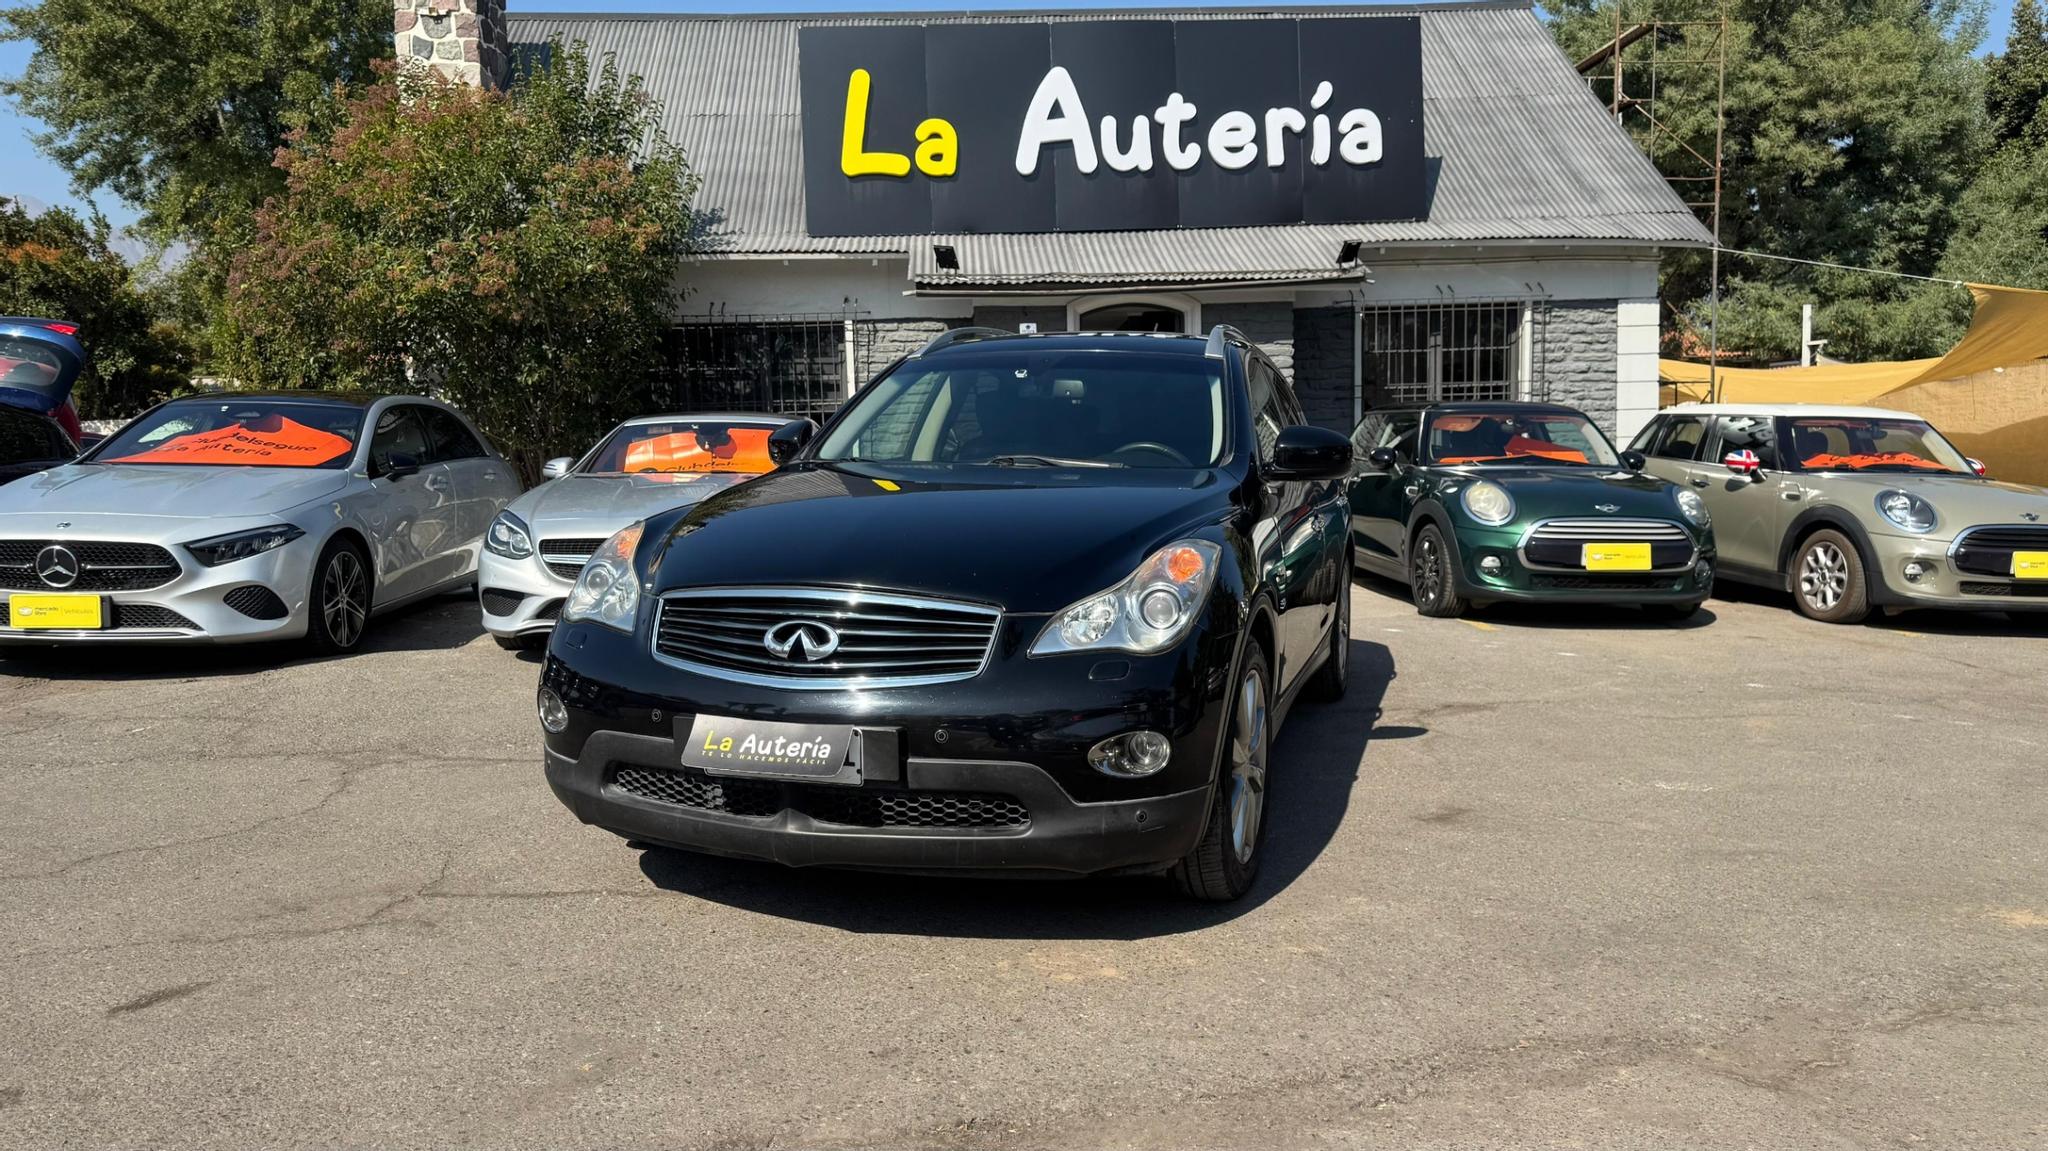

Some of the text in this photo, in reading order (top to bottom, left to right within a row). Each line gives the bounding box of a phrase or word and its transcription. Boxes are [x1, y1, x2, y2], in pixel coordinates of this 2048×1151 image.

[841, 65, 1383, 177] La Autería
[703, 730, 733, 752] La
[739, 733, 831, 758] Autería
